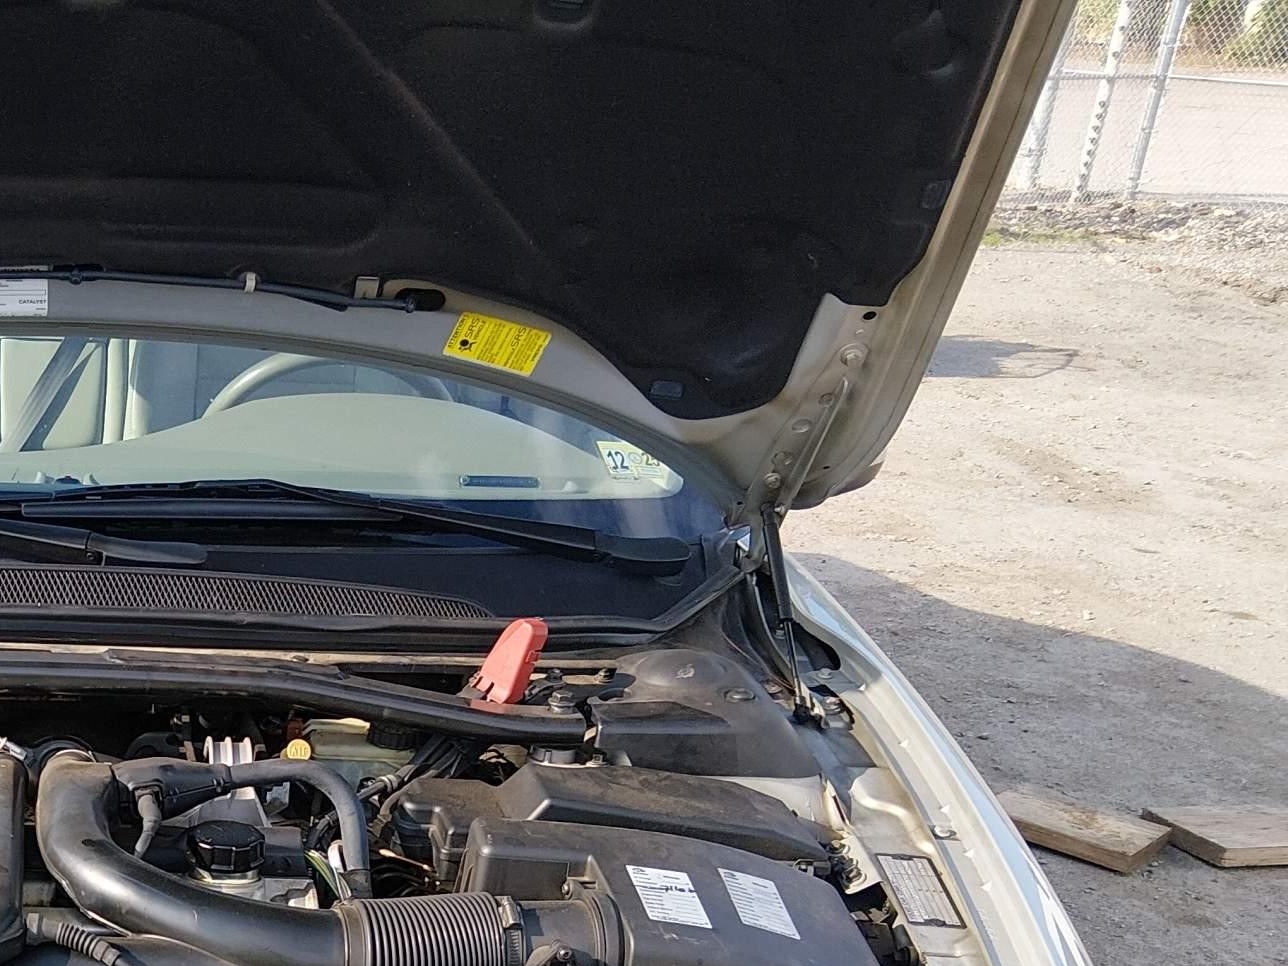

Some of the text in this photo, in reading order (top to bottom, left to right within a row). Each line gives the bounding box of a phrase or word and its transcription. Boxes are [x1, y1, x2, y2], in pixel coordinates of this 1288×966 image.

[465, 317, 480, 338] SRS
[511, 327, 527, 348] SRS
[607, 450, 630, 470] 12
